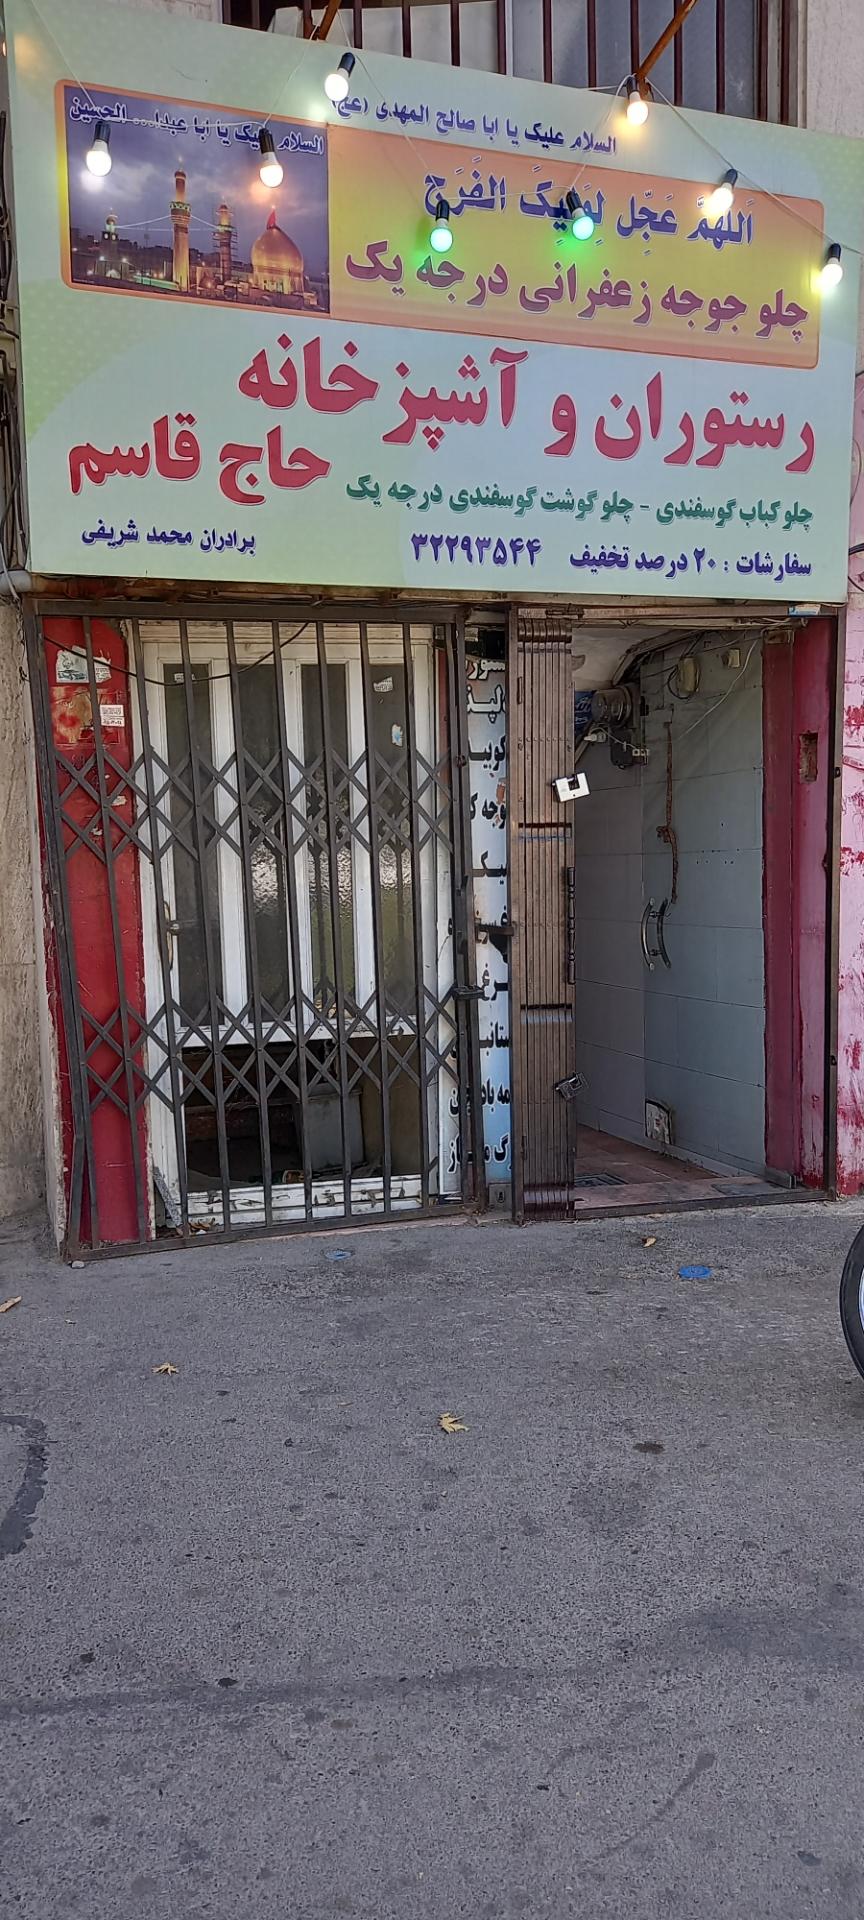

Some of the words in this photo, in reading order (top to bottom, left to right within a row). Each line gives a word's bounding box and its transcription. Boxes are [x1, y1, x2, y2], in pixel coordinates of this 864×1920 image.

[70, 97, 127, 121] الحسین
[376, 102, 430, 125] المهدی
[436, 108, 477, 134] صالح
[193, 117, 210, 141] ابا
[215, 119, 231, 146] یا
[277, 130, 325, 155] السلام
[483, 116, 499, 141] ابا
[506, 122, 520, 146] یا
[524, 123, 564, 149] علیک
[570, 132, 617, 154] السلام
[344, 240, 404, 295] یک
[416, 253, 509, 307] درجه
[518, 261, 650, 326] زعفرانی
[660, 282, 748, 333] جوجه
[756, 289, 809, 343] چلو
[238, 333, 530, 452] آشپزخانه
[543, 392, 577, 457] و
[594, 371, 816, 473] رستوران
[68, 412, 202, 495] قاسم
[217, 424, 332, 506] حاج
[345, 474, 382, 508] یک
[387, 483, 443, 514] درجه
[449, 485, 537, 516] گوسفندی
[540, 488, 599, 521] گوشت
[602, 489, 634, 524] چلو
[656, 496, 737, 529] گوسفندی
[739, 499, 782, 527] کباب
[783, 502, 814, 531] چلو
[81, 519, 139, 548] شریفی
[146, 525, 193, 546] محمد
[200, 528, 257, 558] برادران
[411, 532, 542, 568] ۳۲۲۹۳۵۴۴
[569, 544, 630, 574] تخفیف
[635, 552, 688, 578] درصد
[693, 547, 718, 574] ۲۰
[736, 551, 812, 582] سفارشات
